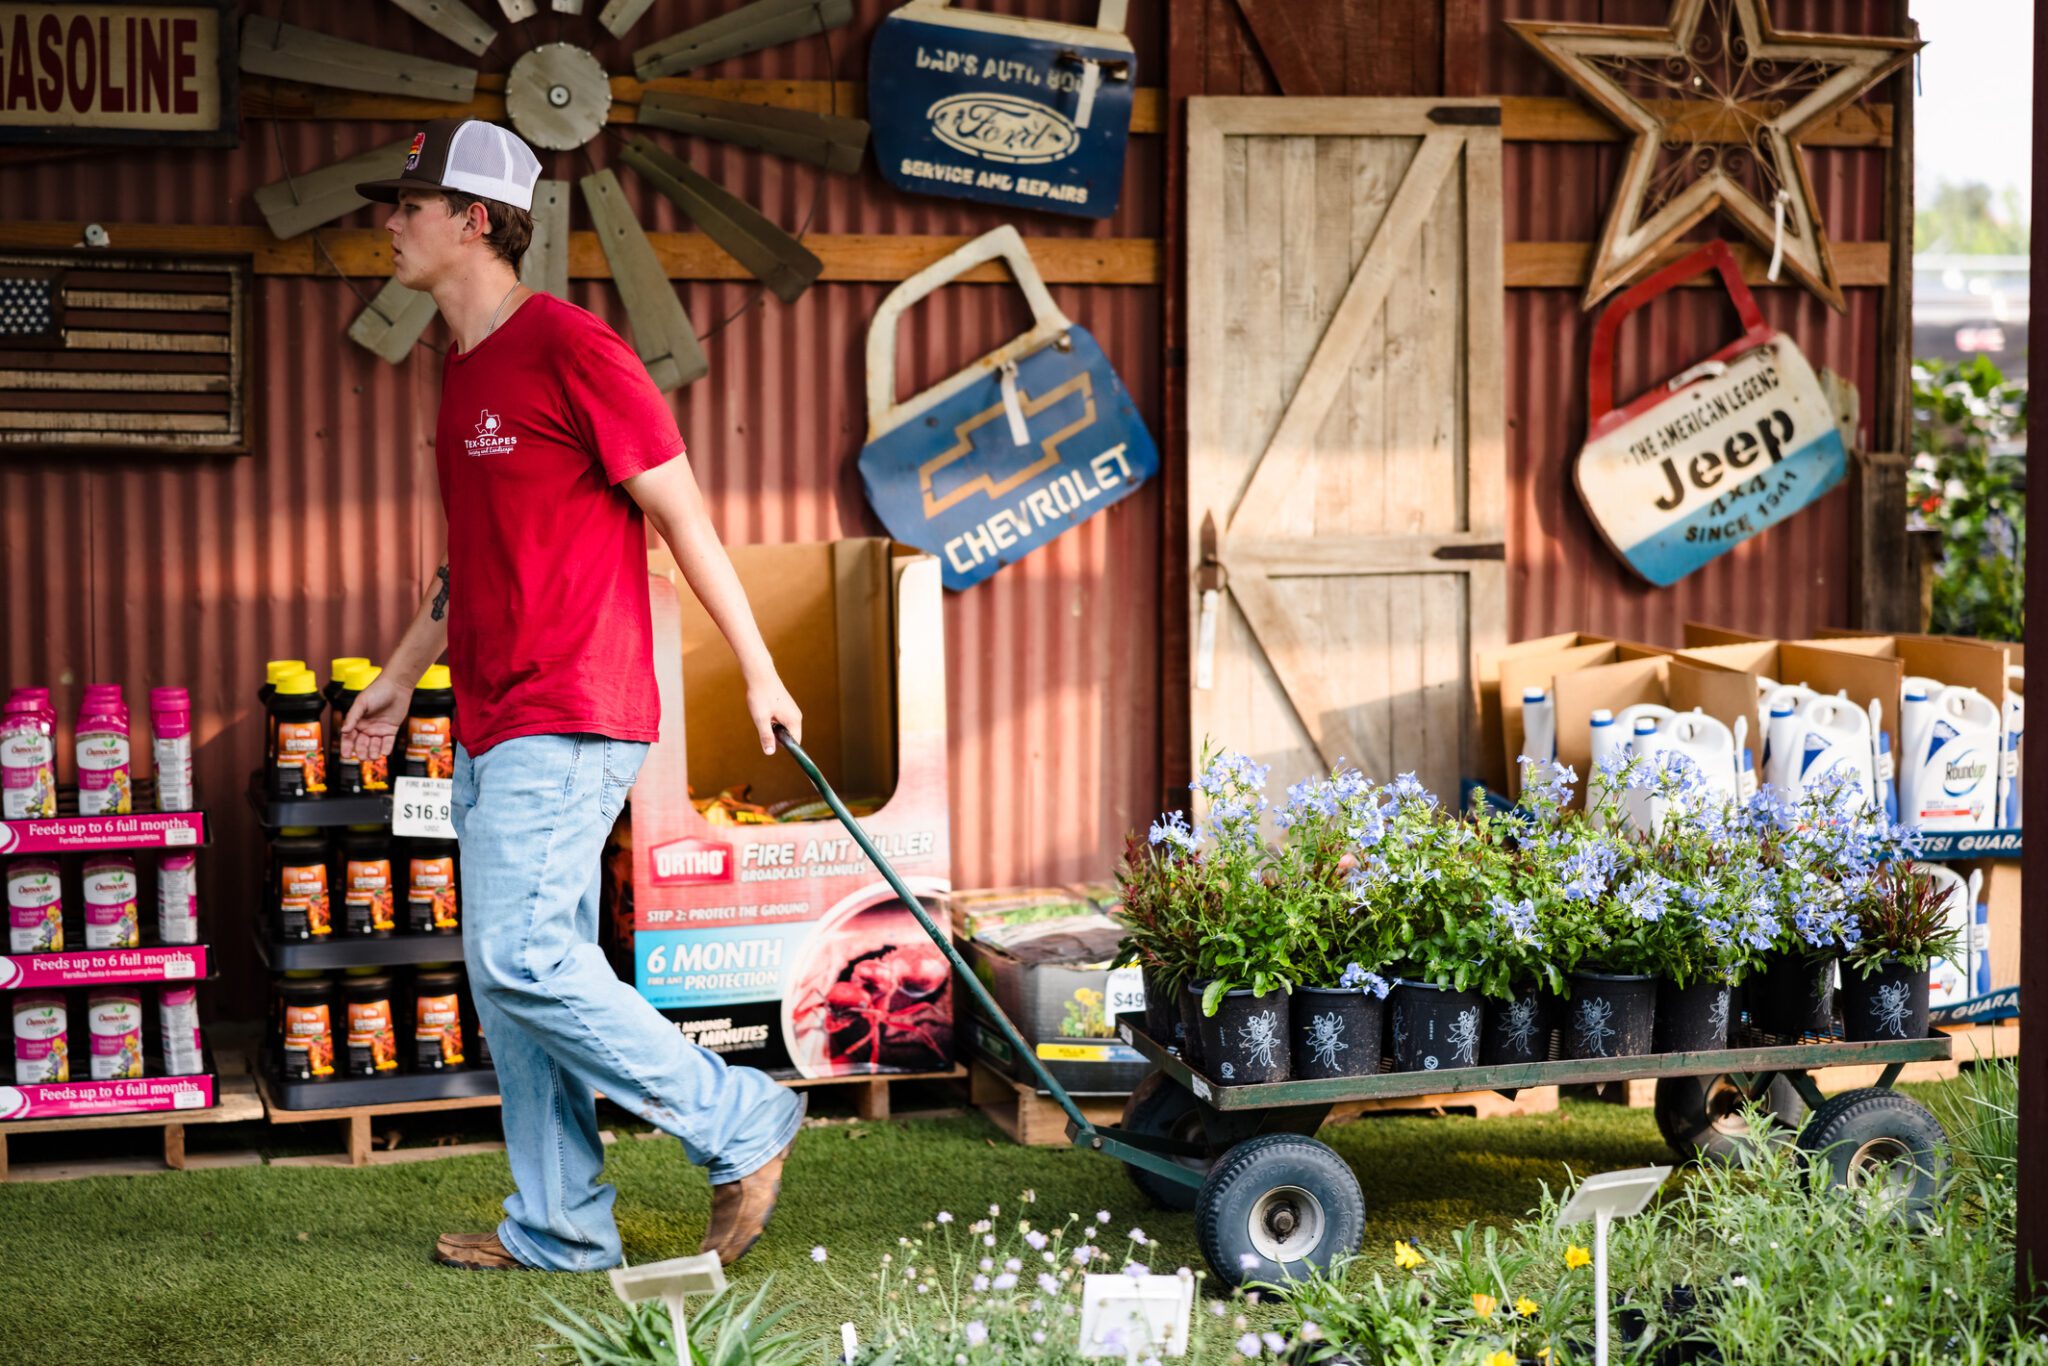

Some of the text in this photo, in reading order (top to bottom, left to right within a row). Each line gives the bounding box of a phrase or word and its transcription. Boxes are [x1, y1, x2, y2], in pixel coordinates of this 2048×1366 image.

[0, 13, 198, 114] ASOLINE
[954, 104, 1052, 151] Ford
[900, 158, 1088, 204] SERVICE AND REPAIRS
[1628, 367, 1781, 466] THE AMERICAN LEGEND
[1654, 408, 1796, 511] Jeep
[943, 443, 1133, 574] CHEVROLET
[1684, 469, 1799, 543] SINCE 1941
[29, 816, 189, 837] Feeds up to 6 full months
[656, 849, 725, 879] ORTHO
[740, 841, 795, 868] FIRE
[801, 839, 852, 865] ANT
[740, 865, 806, 883] BROADCAST
[808, 861, 867, 879] GRANULES
[646, 902, 809, 923] STEP 2: PROTECT THE GROUND
[33, 950, 192, 971] Feeds up to 6 full months
[646, 938, 784, 973] 6 MONTH
[684, 971, 779, 991] PROTECTION
[697, 1024, 769, 1047] MINUTES
[39, 1080, 199, 1101] Feeds up to 6 full months
